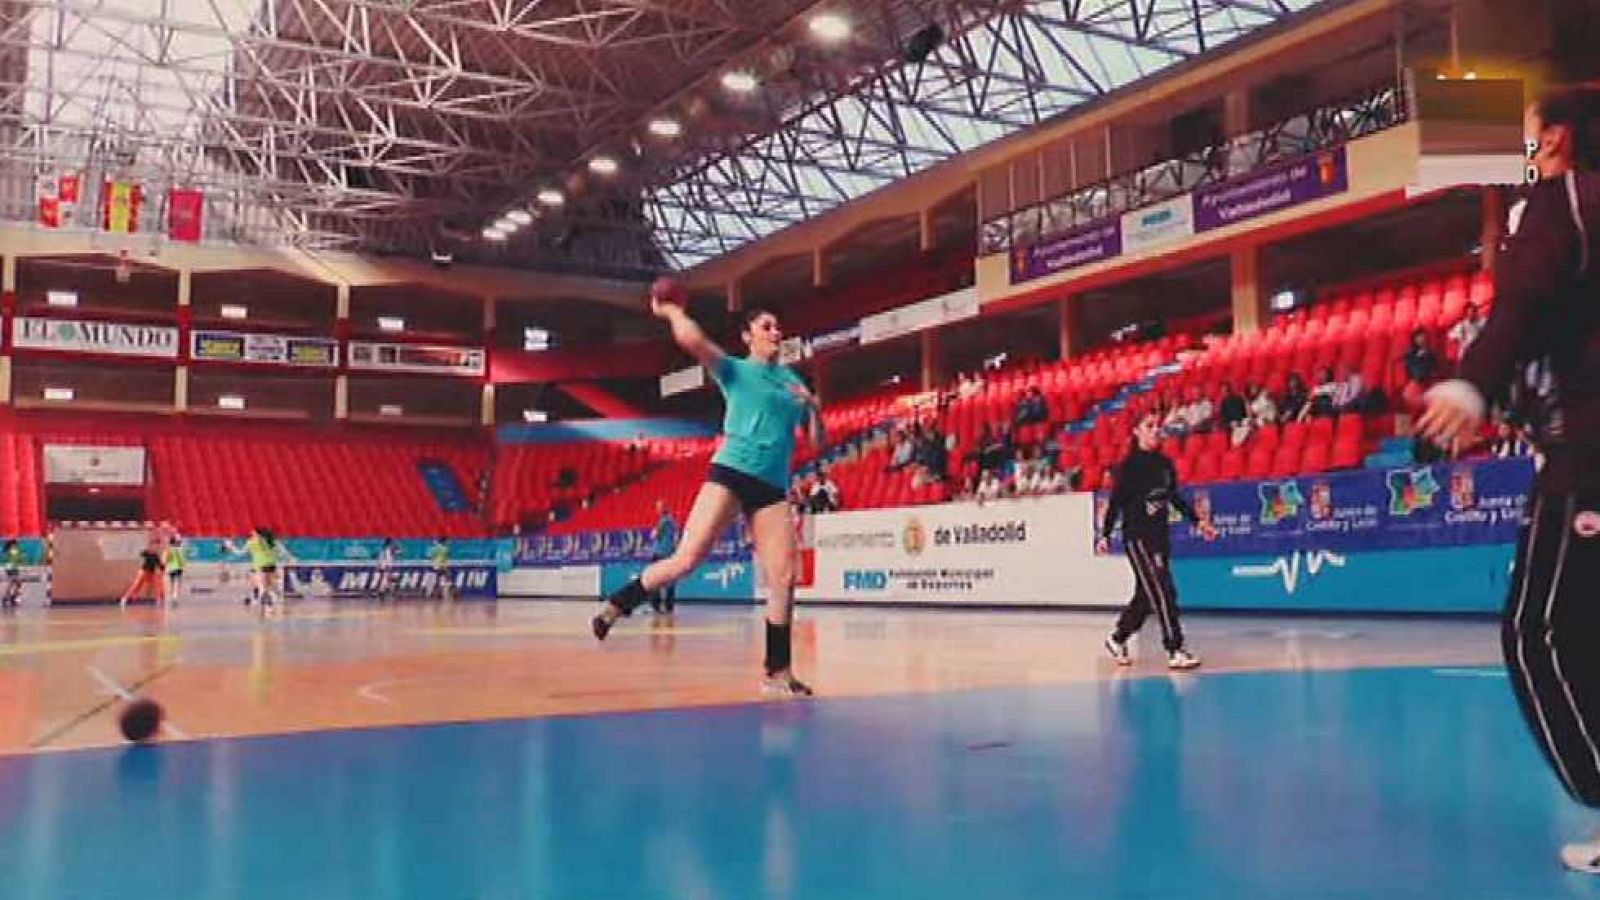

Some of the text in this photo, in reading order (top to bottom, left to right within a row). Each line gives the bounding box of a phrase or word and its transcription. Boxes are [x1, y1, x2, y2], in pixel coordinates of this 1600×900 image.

[22, 320, 56, 341] EL
[79, 322, 173, 348] MUNDO
[933, 525, 951, 546] de
[953, 520, 1027, 545] Valladolid
[843, 568, 888, 589] FMD
